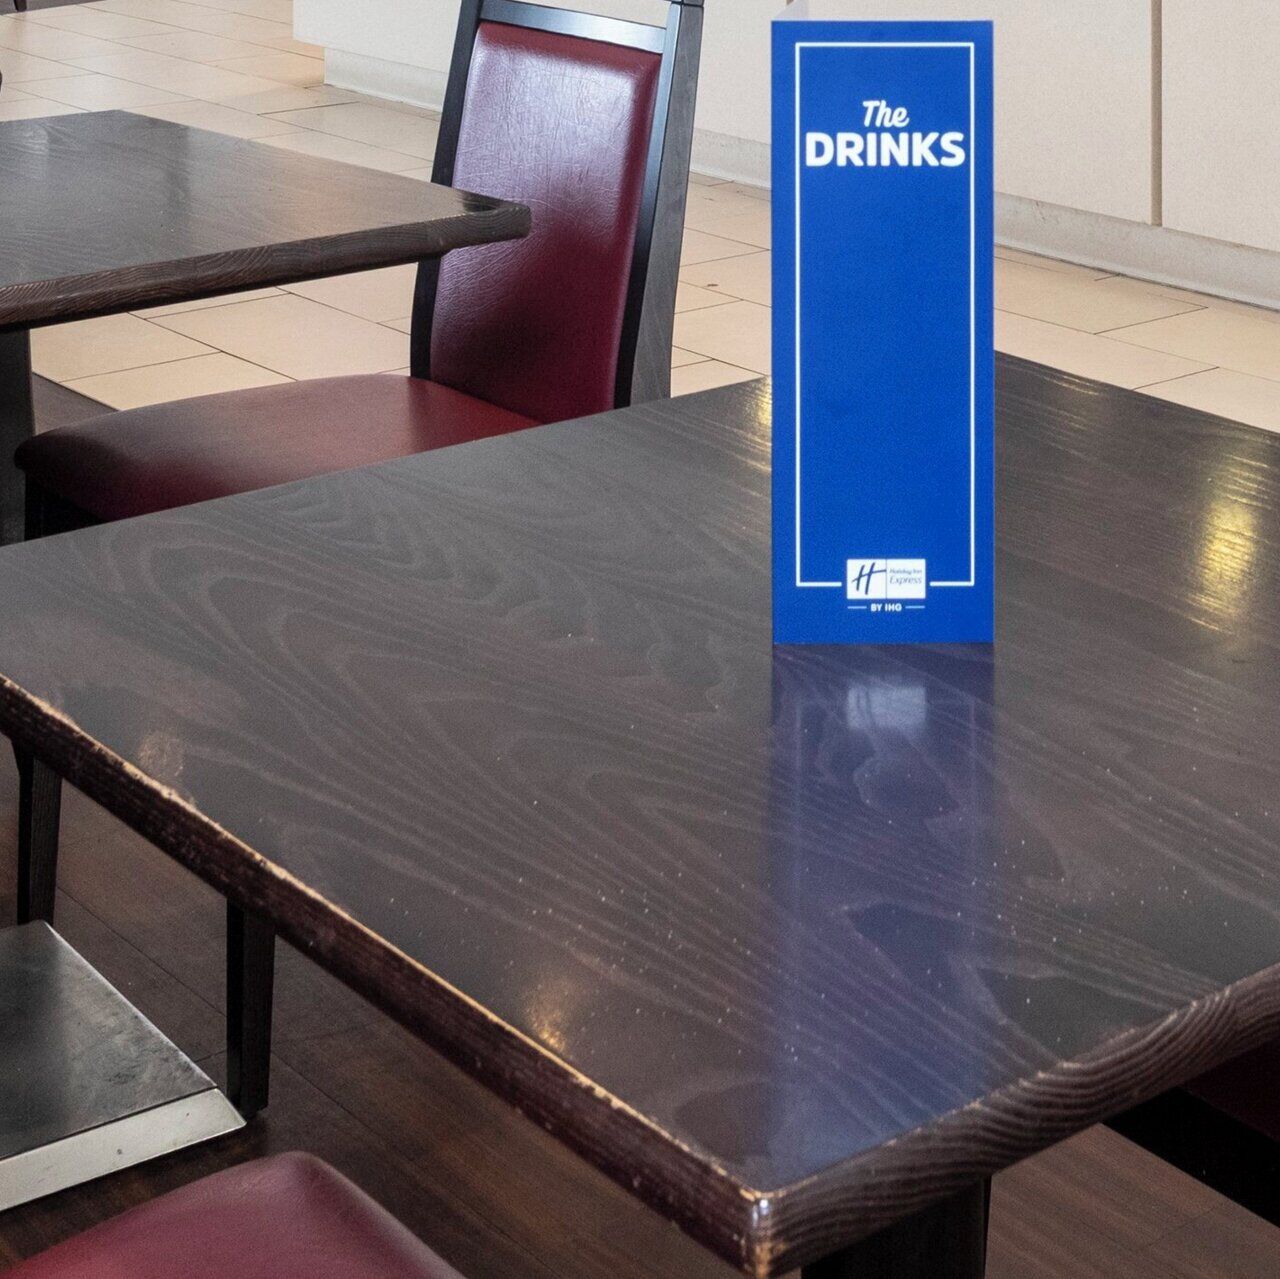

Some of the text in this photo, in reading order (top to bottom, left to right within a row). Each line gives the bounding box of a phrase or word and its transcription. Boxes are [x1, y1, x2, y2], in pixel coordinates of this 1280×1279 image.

[862, 100, 910, 128] The
[805, 131, 966, 168] DRINKS
[889, 575, 923, 586] Express
[870, 603, 882, 612] BY
